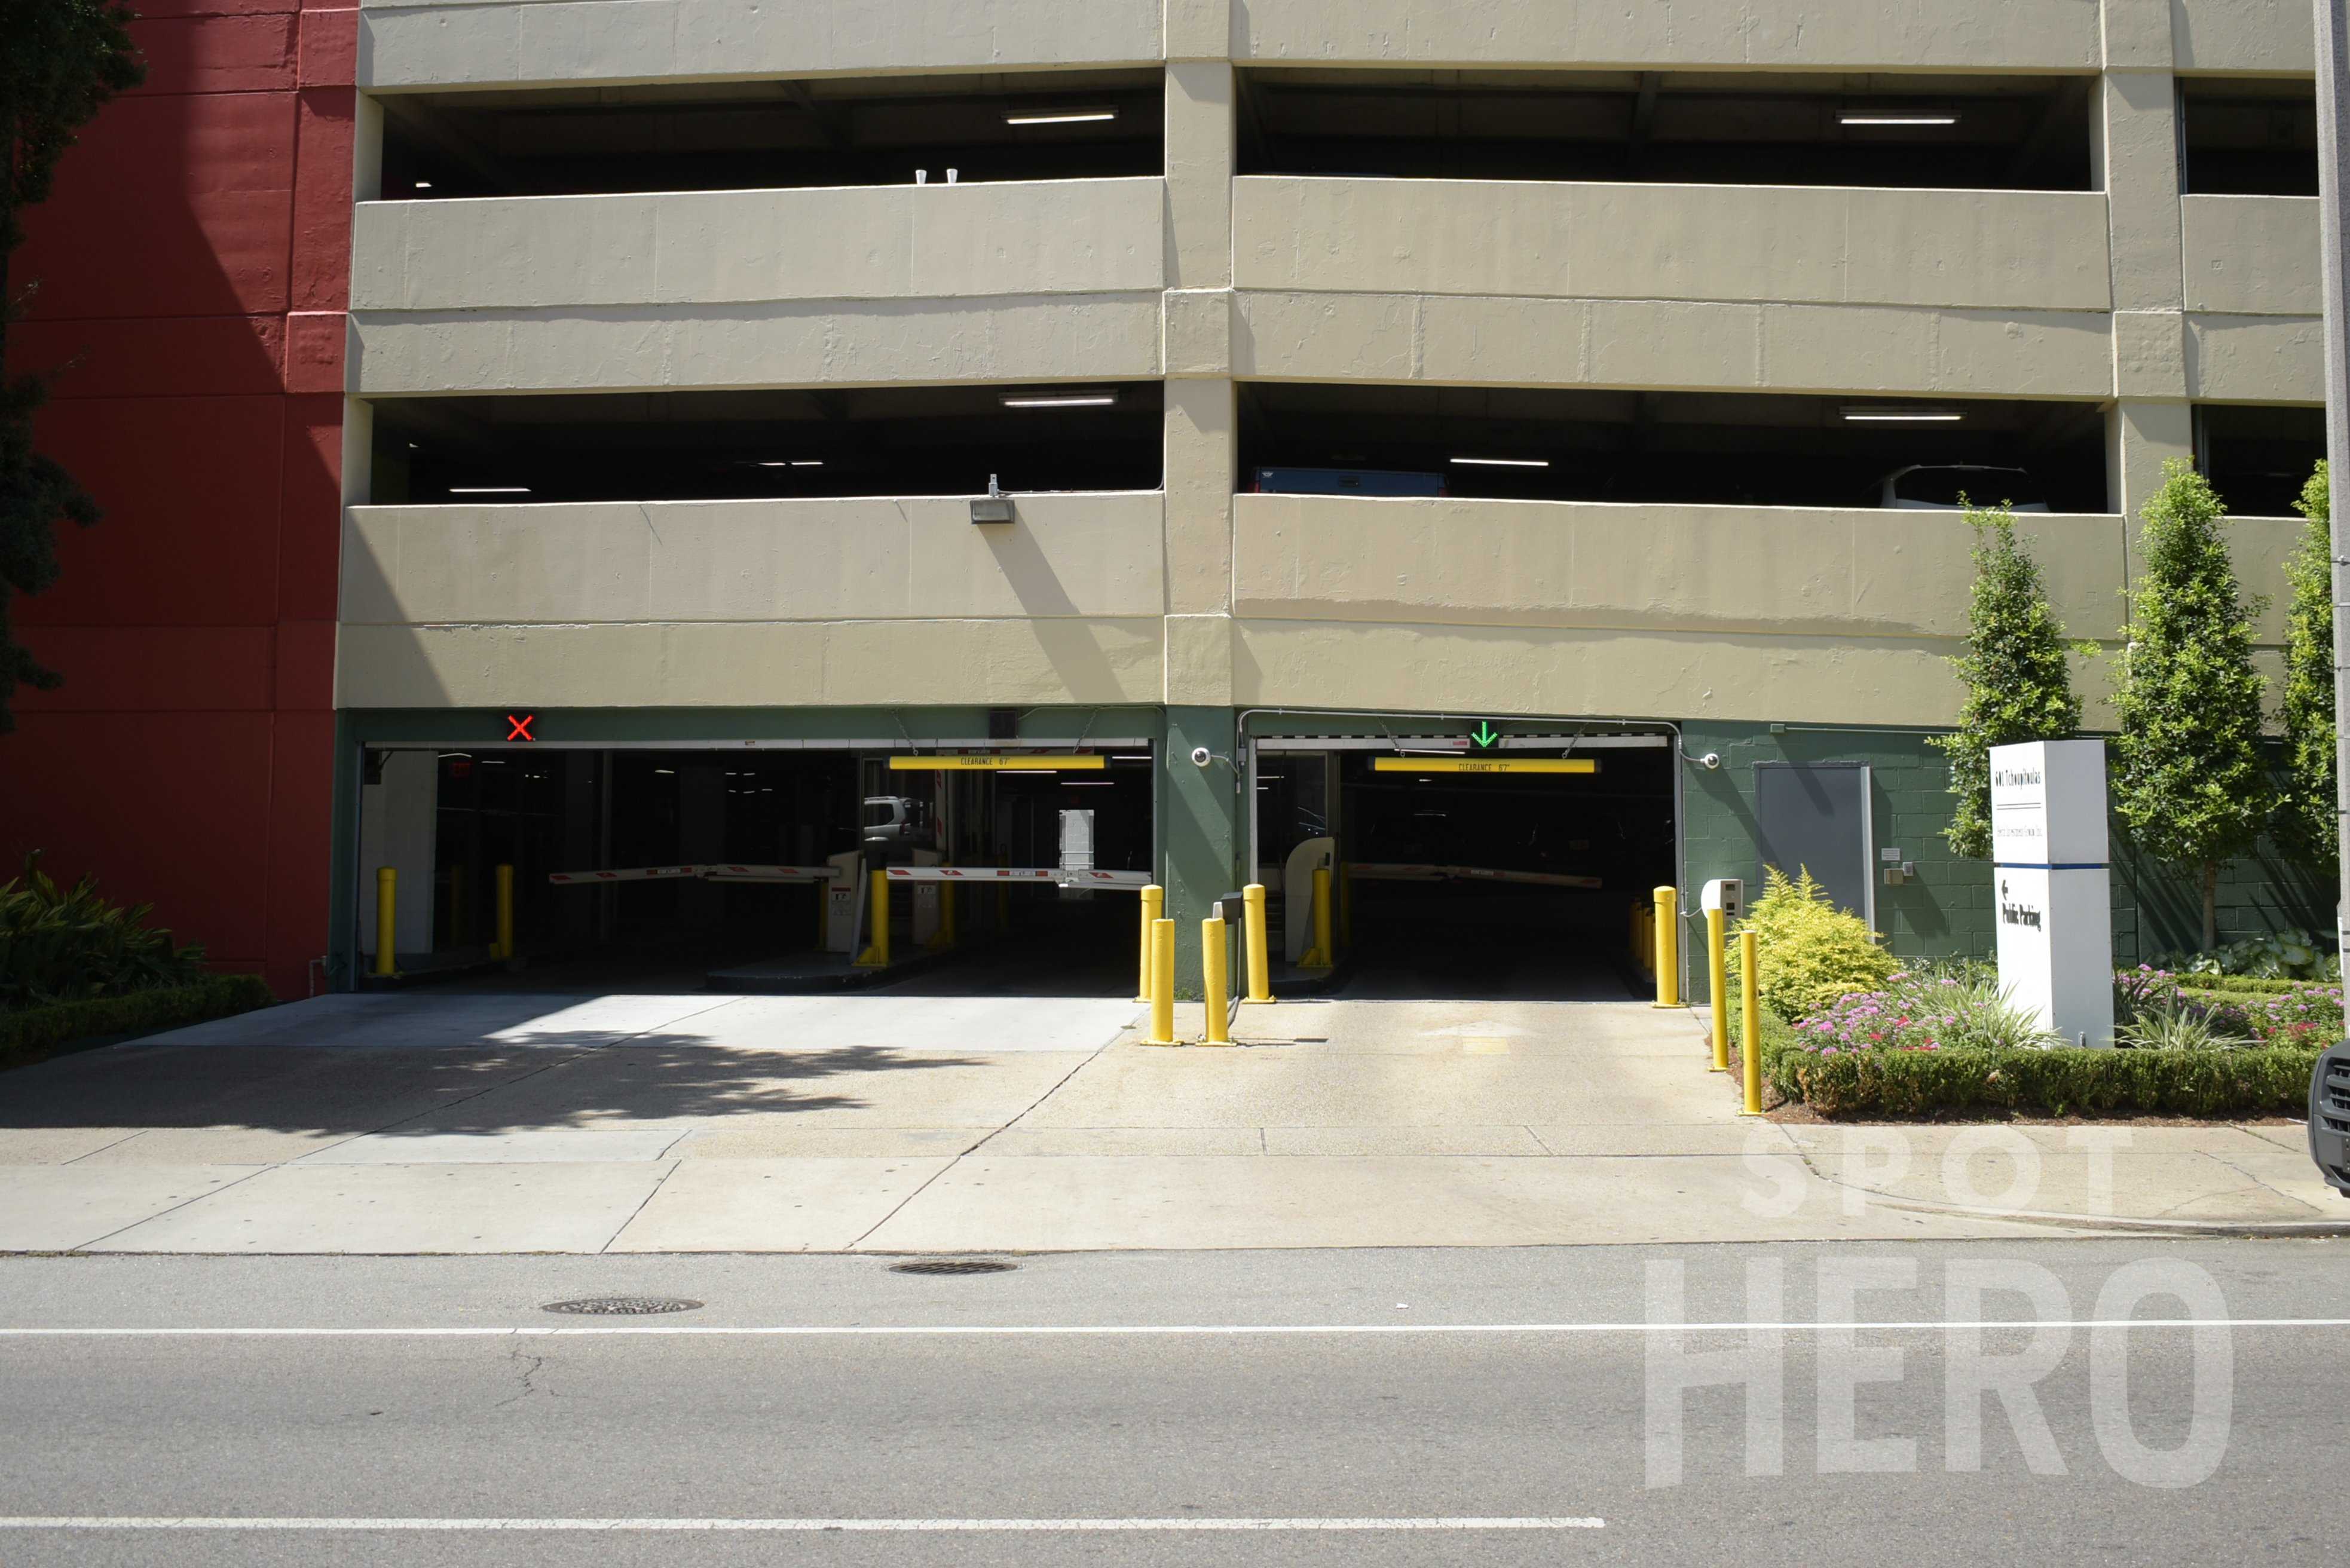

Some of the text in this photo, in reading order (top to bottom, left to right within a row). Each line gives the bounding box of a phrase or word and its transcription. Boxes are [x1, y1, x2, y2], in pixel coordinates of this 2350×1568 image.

[960, 757, 993, 765] CLEARANCE
[2002, 902, 2041, 933] Public Parking
